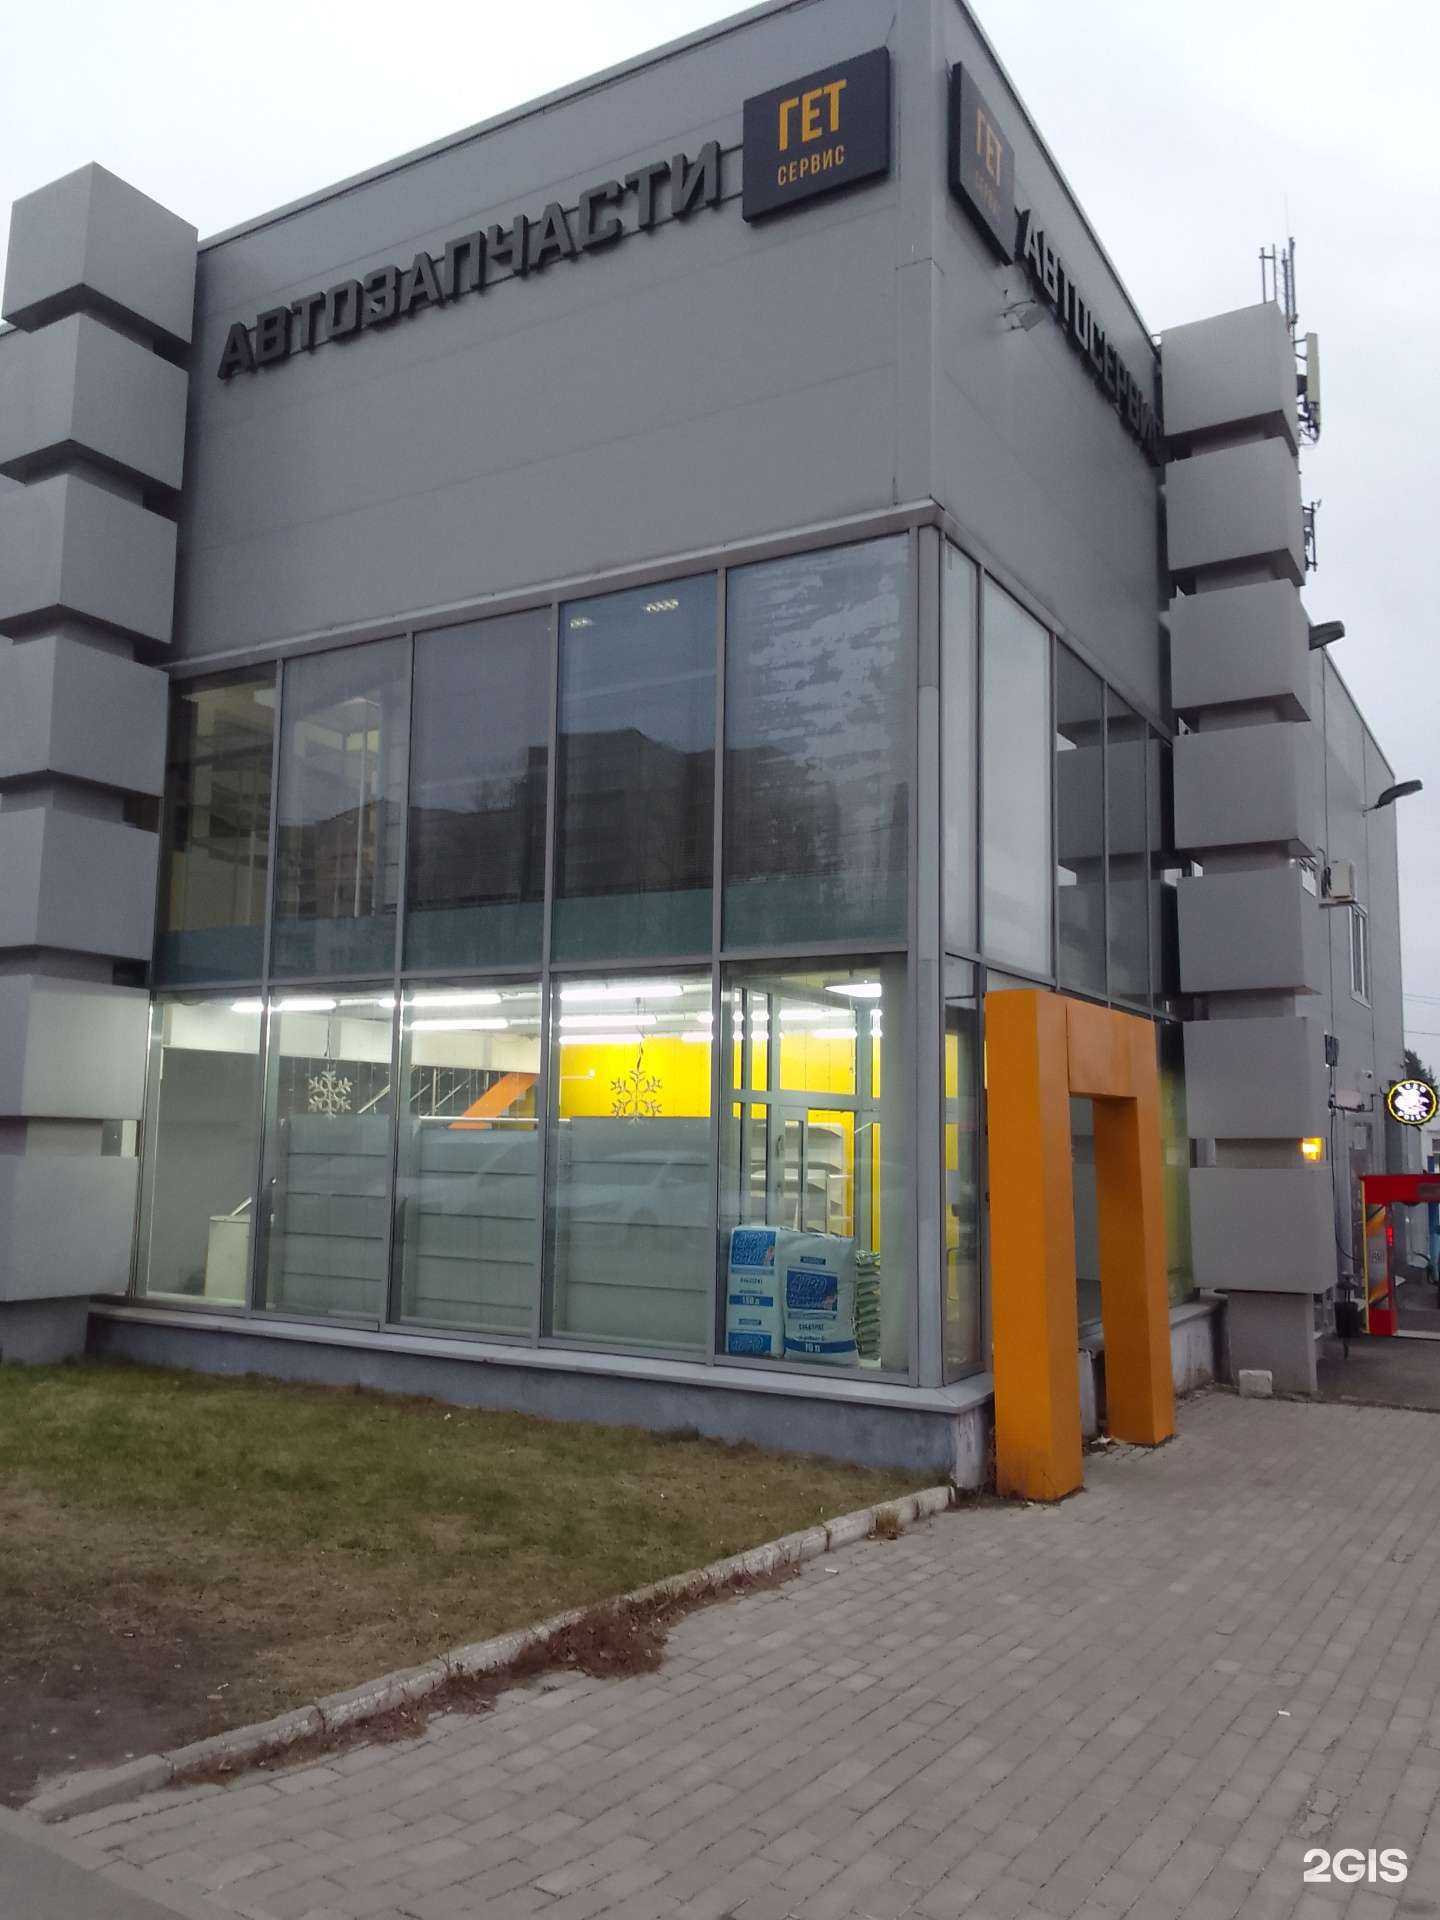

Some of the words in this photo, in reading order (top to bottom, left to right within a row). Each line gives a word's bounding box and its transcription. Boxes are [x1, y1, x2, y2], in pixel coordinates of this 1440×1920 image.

[779, 79, 848, 152] ГЕТ
[777, 144, 845, 187] СЕРВИС
[218, 140, 722, 379] АВТОЗАПЧАСТИ
